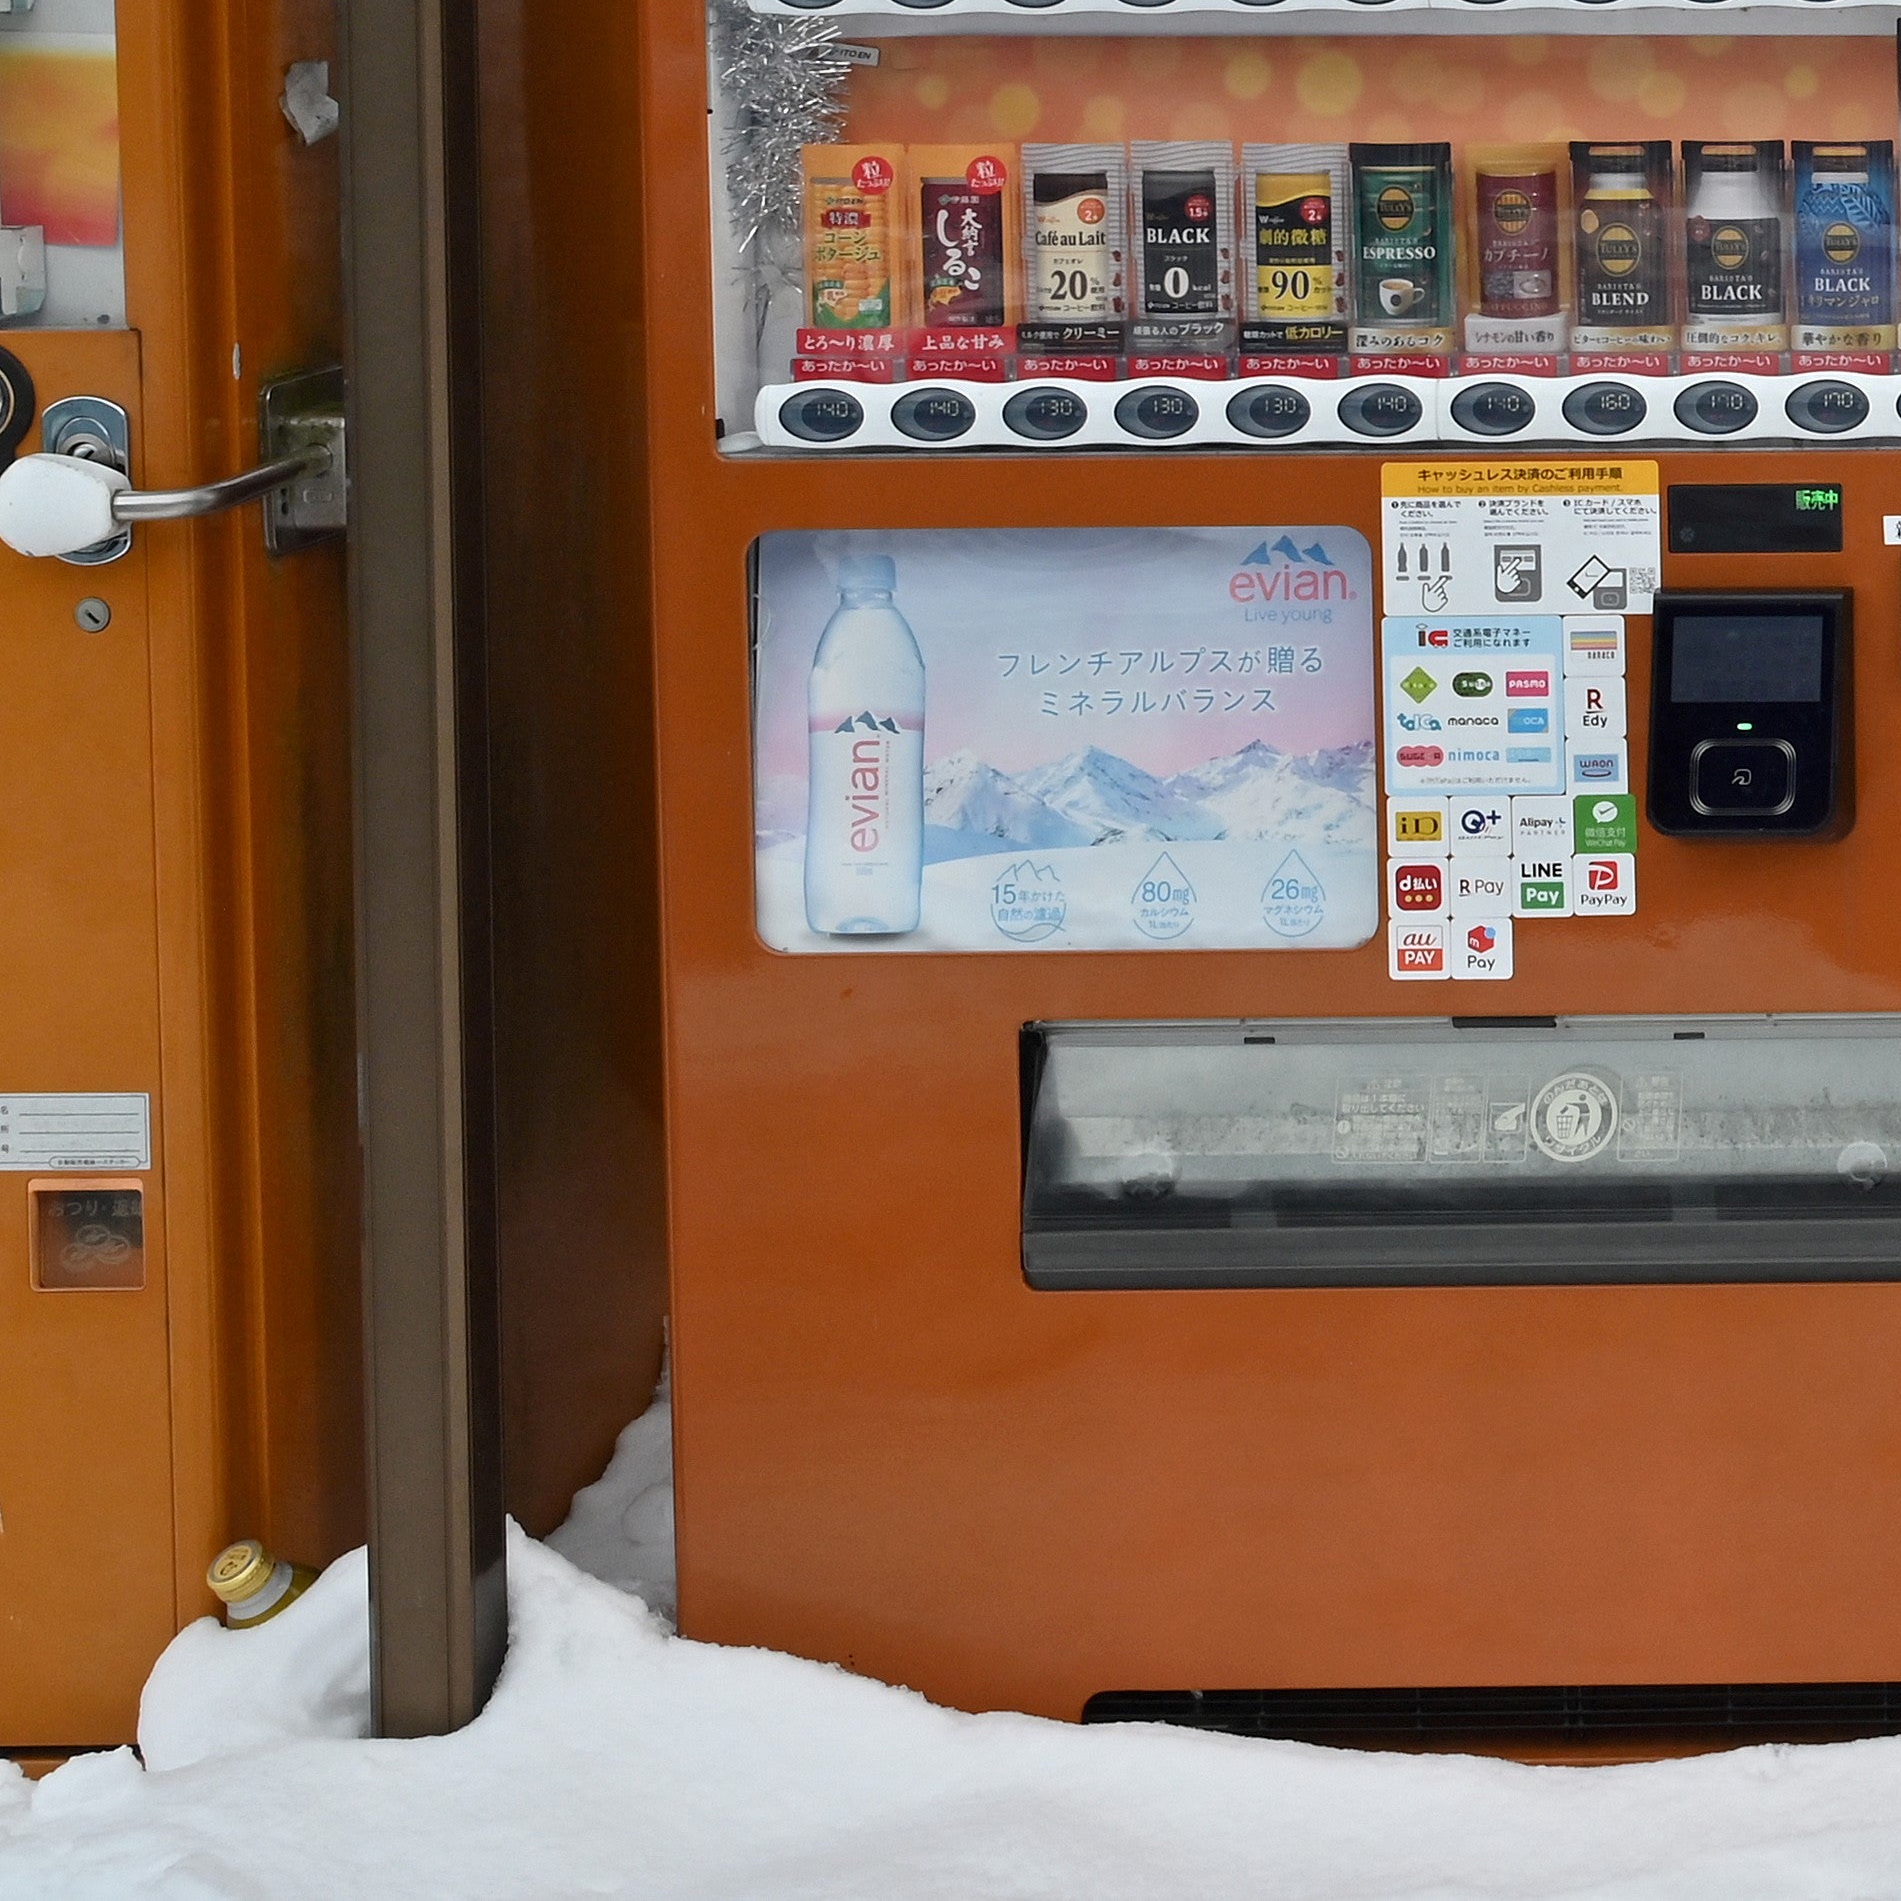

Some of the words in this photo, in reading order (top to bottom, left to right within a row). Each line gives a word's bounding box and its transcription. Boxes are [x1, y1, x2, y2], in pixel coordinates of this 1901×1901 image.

[824, 231, 866, 245] コーン
[1035, 229, 1058, 245] Café
[1060, 234, 1077, 245] au
[1078, 230, 1106, 245] Lait
[1147, 227, 1211, 244] BLACK
[815, 248, 881, 262] ポタージュ
[1363, 246, 1436, 260] ESPRESSO
[1050, 269, 1089, 301] 20
[1271, 269, 1310, 300] 90
[1814, 276, 1871, 292] BLACK
[1591, 291, 1649, 306] BLEND
[1701, 284, 1763, 301] BLACK
[1063, 327, 1120, 341] クリーミー
[1356, 334, 1443, 348] 深みのあるコク
[1802, 333, 1882, 347] 華やかな香り
[922, 334, 1005, 350] 上品な甘み
[1418, 467, 1623, 481] キャッシュレス決済のご利用手順
[1795, 489, 1839, 511] 販売中
[1245, 606, 1278, 622] Live
[1282, 607, 1333, 625] young
[1453, 628, 1531, 638] 交通系電子マネー
[1453, 638, 1531, 648] ご利用になれます
[998, 646, 1324, 678] フレンチアルプスが贈る
[1509, 679, 1546, 689] PASMO
[1041, 687, 1276, 717] ミネラルバランス
[1448, 717, 1499, 726] manaca
[1583, 715, 1608, 728] Edy
[1448, 748, 1500, 762] nimoca
[1521, 863, 1562, 877] LINE
[1400, 874, 1438, 891] d払い
[1580, 894, 1628, 908] PayPay
[1139, 907, 1189, 917] カルシウム
[1263, 904, 1325, 917] マグネシウム
[1405, 951, 1435, 965] PAY
